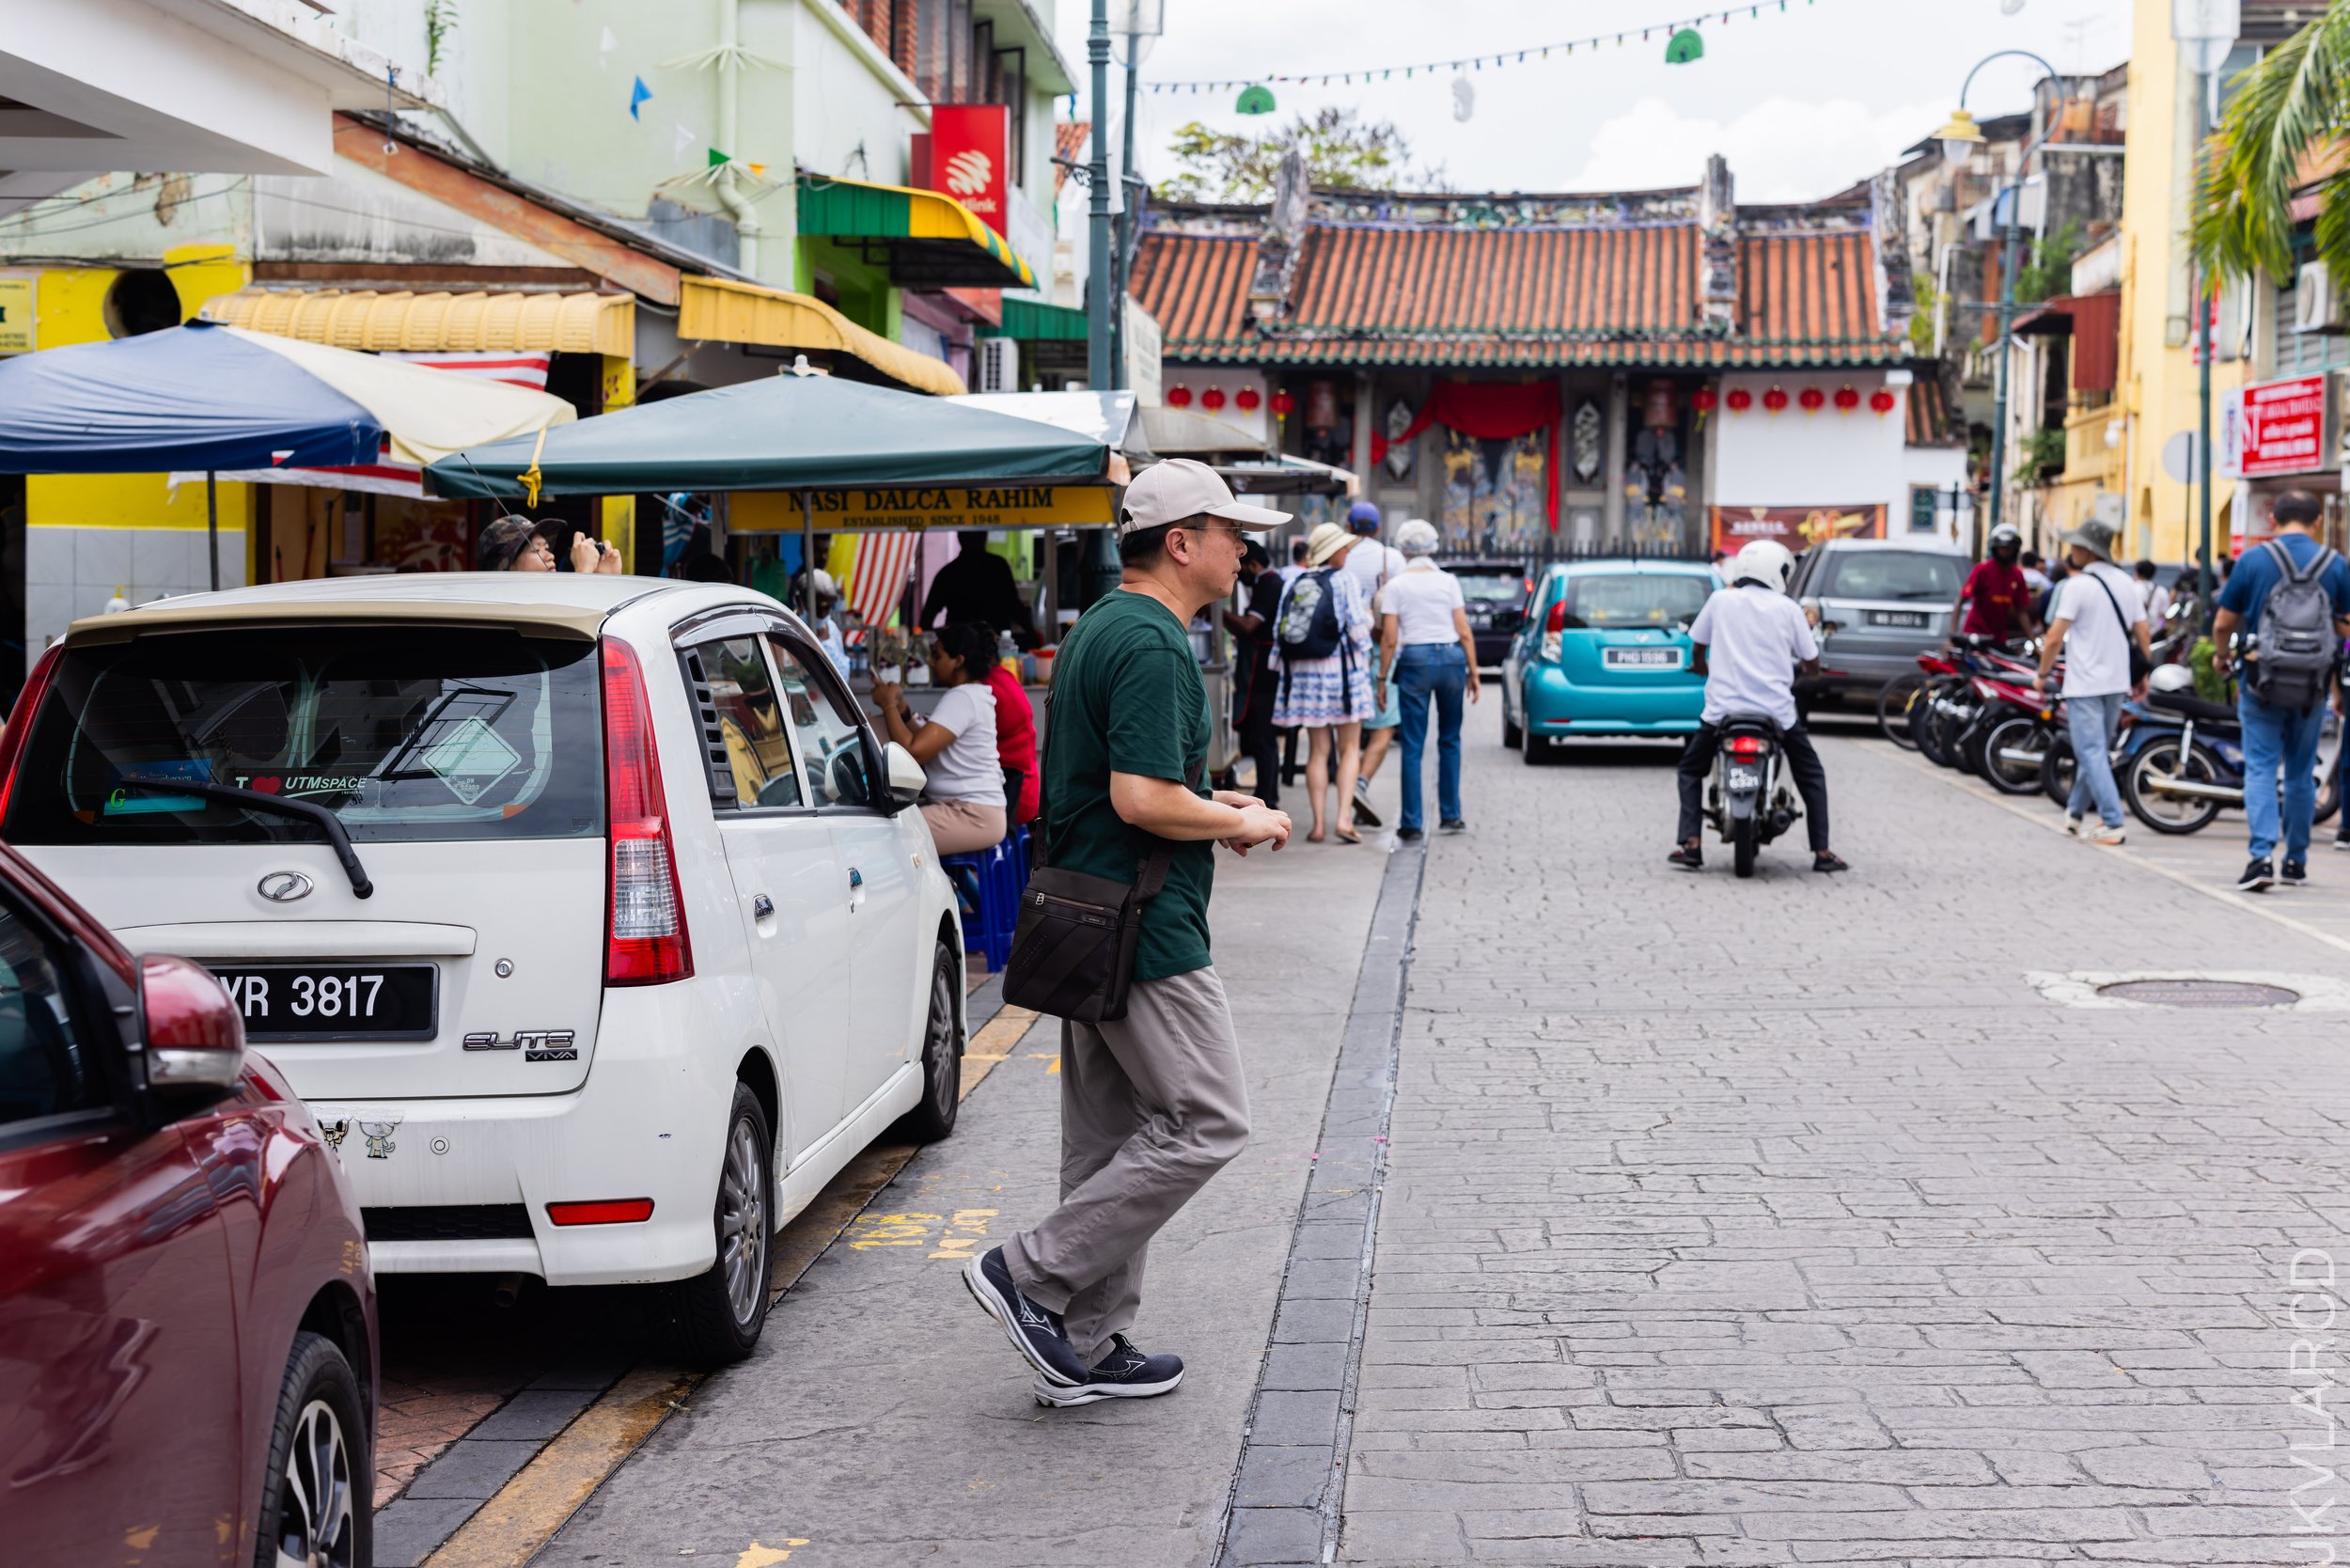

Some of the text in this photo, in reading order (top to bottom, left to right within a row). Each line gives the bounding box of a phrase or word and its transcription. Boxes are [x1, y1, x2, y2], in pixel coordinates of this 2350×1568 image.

[789, 488, 1054, 511] NASI DALCA RAHIM
[843, 516, 924, 526] ESTABLISHED
[931, 515, 964, 525] SINCE
[285, 776, 368, 790] UTMSPACE
[213, 975, 384, 1017] YR 3817
[462, 1029, 575, 1051] ELITE
